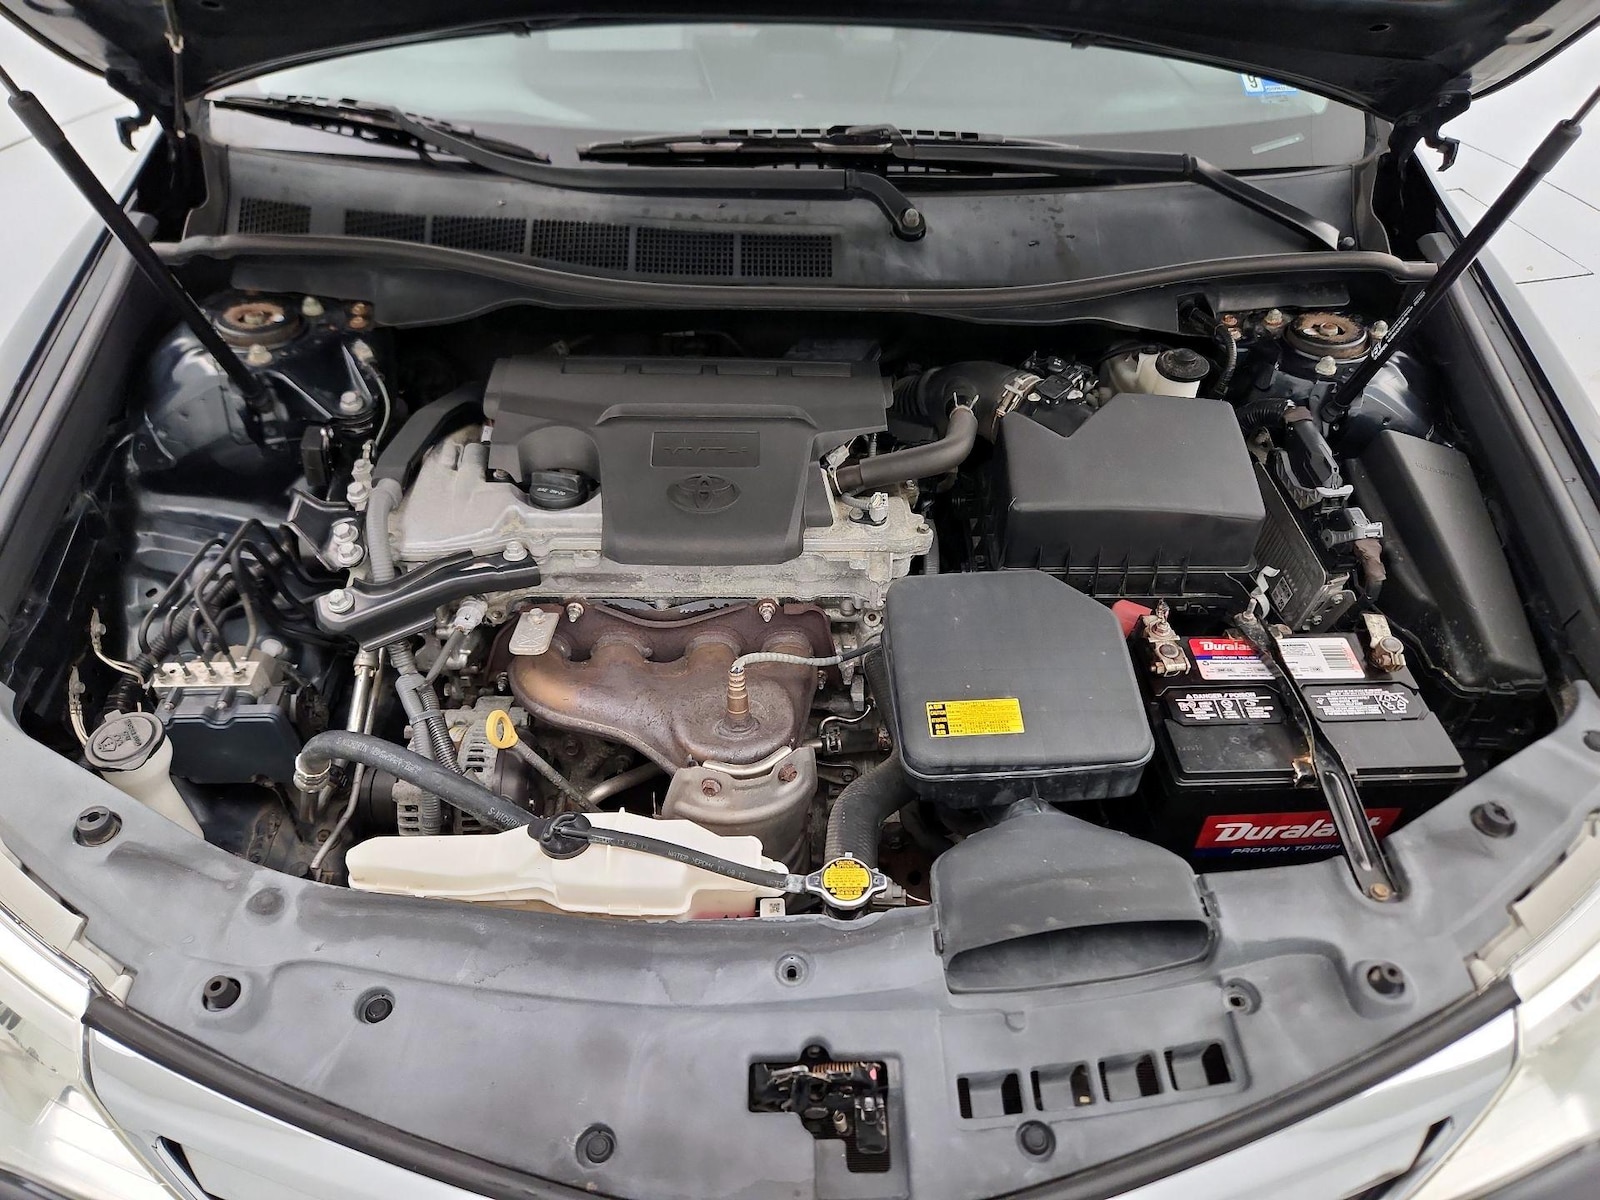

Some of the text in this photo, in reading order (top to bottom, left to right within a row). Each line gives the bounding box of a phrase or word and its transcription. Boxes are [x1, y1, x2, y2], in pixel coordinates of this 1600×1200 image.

[1199, 641, 1252, 651] Durala
[1214, 815, 1382, 842] Durala
[1231, 843, 1341, 854] PROVEN TOUGH
